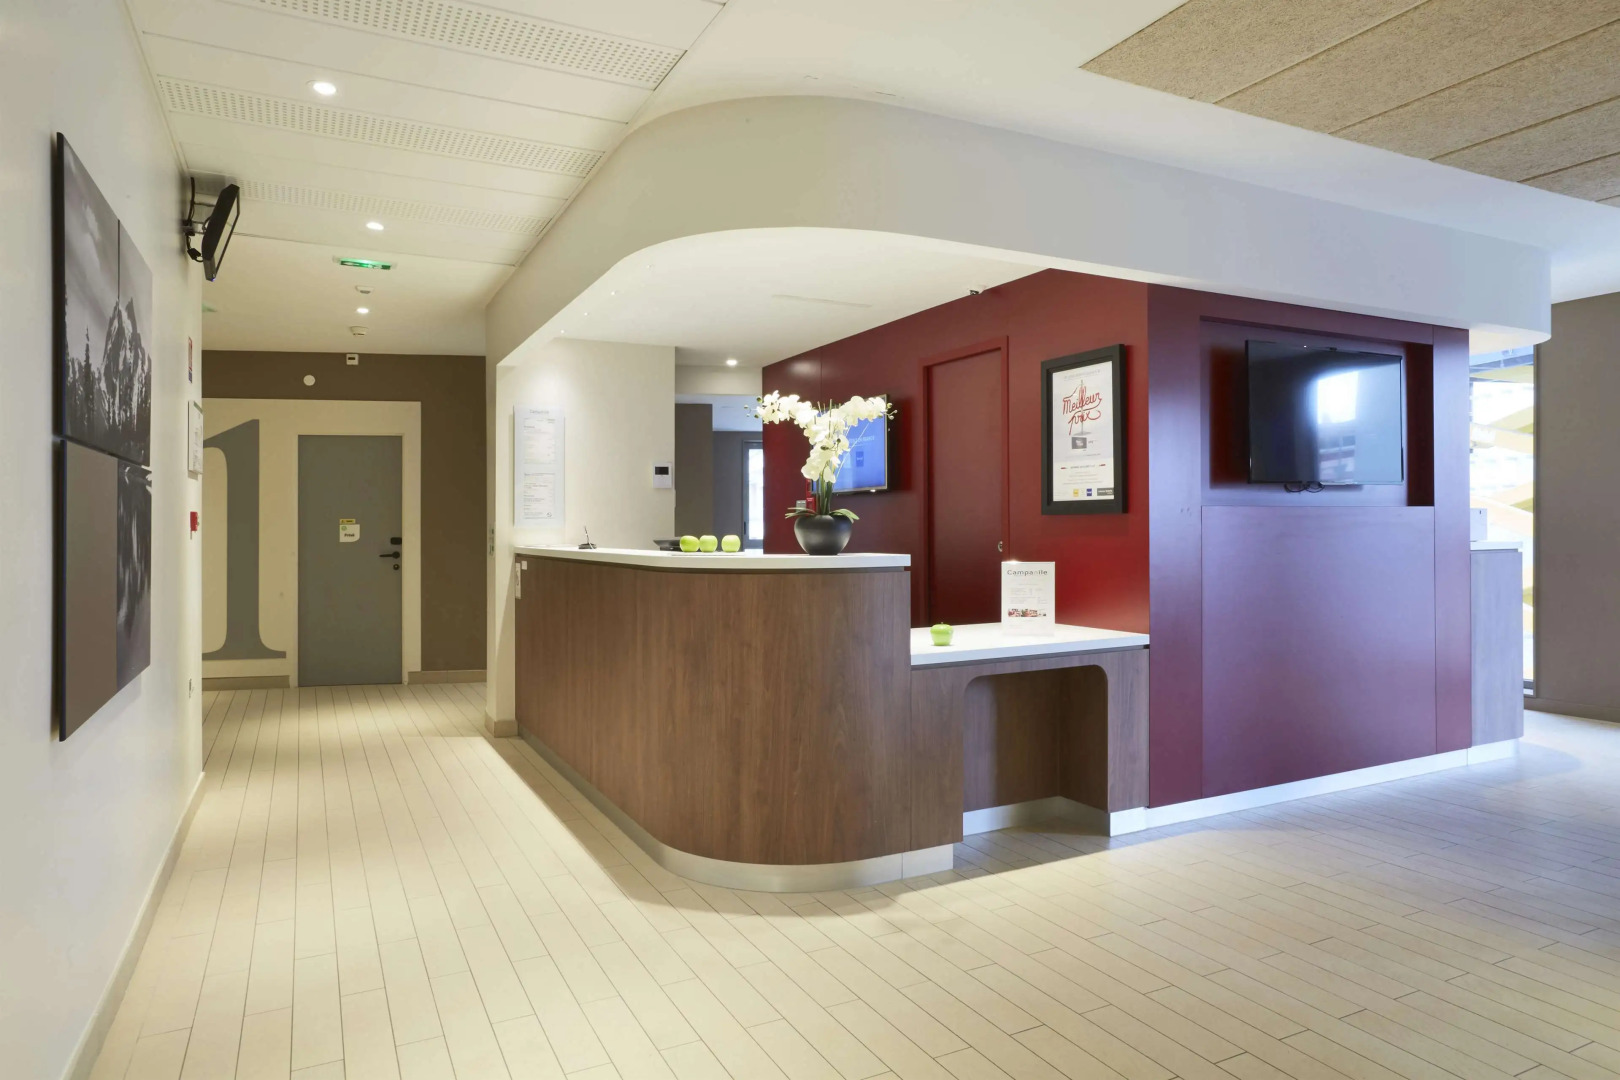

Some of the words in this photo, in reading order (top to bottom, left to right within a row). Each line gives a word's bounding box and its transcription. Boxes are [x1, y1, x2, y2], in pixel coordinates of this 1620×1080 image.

[1062, 384, 1102, 415] Meilleur
[1068, 410, 1101, 436] prix
[1007, 569, 1048, 577] Campanile
